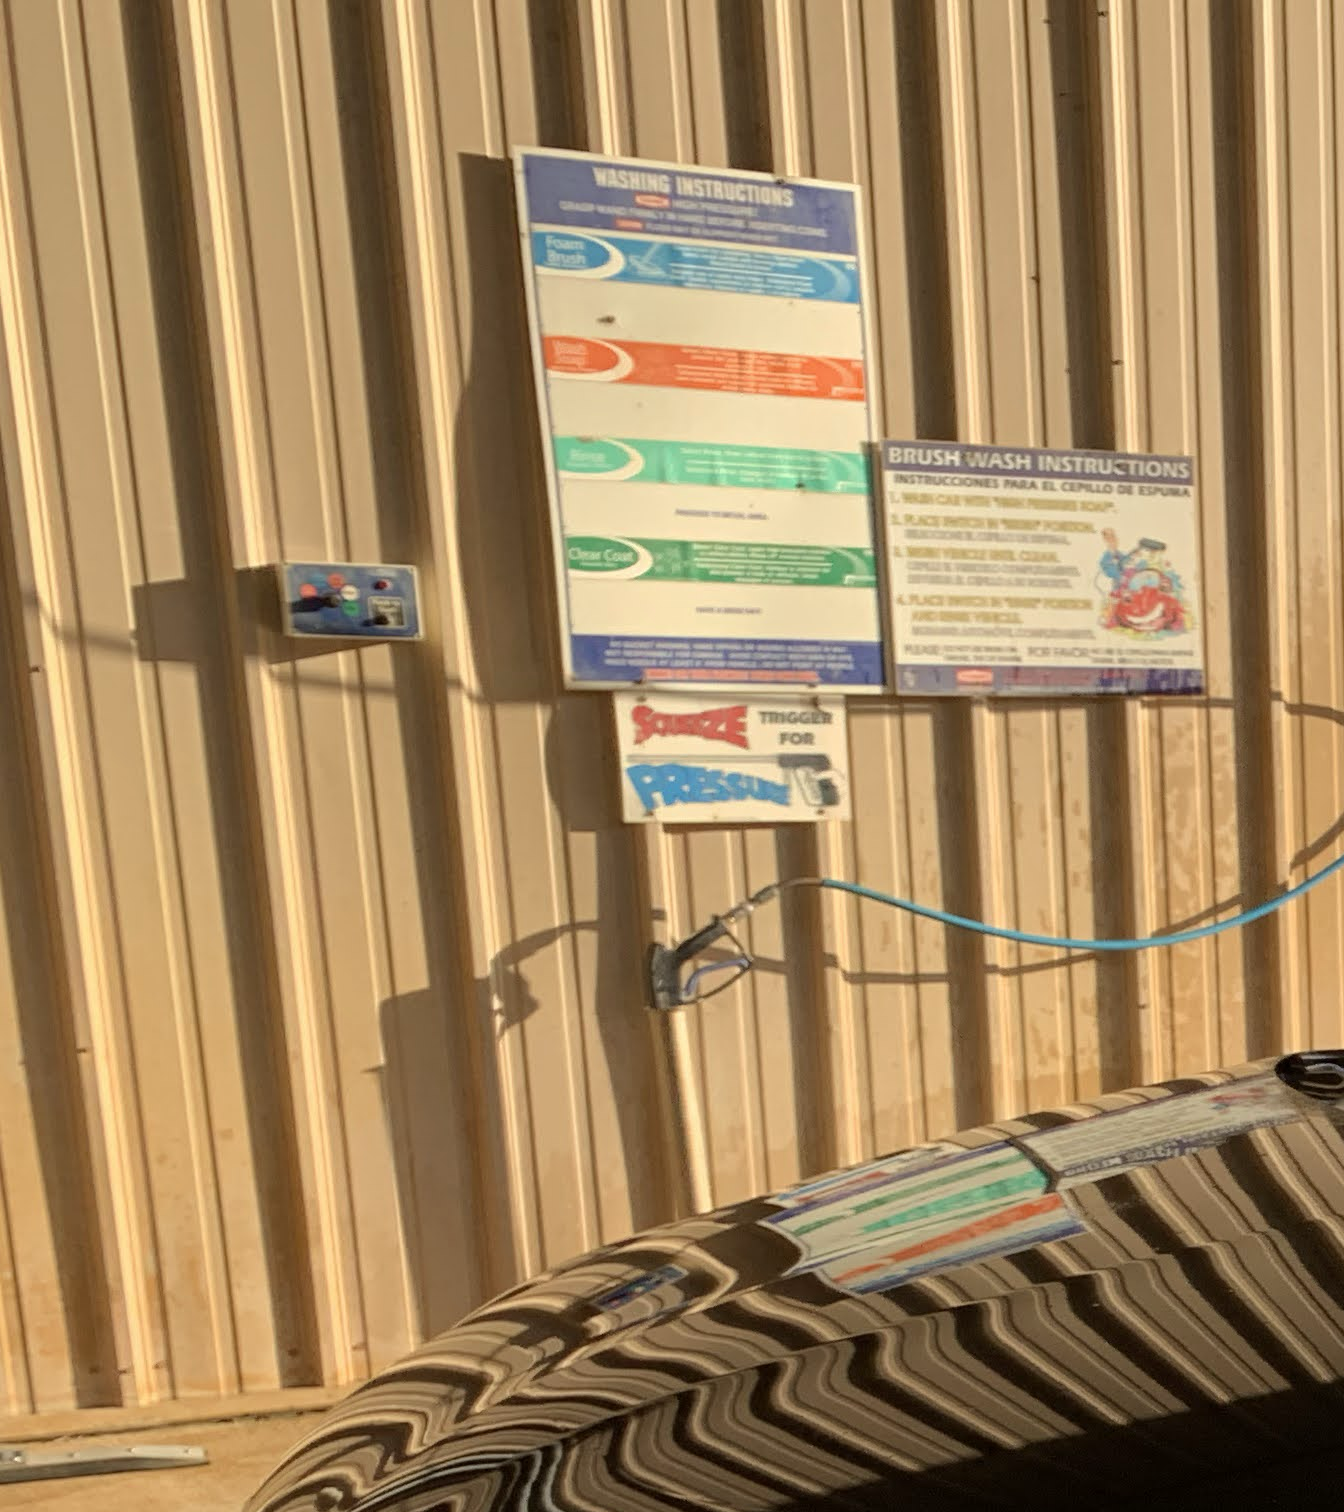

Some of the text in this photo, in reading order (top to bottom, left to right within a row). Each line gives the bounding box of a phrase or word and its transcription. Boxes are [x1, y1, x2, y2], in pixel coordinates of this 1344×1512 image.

[593, 166, 671, 194] WASHING
[675, 175, 795, 207] INSTRUCTIONS
[545, 235, 585, 250] Foam
[546, 249, 586, 265] Brush
[888, 446, 1191, 479] BRUSH WASH INSTRUCTIONS
[893, 473, 1191, 498] INSTRUCCIONES PARA EL CEPILLO DE ESPUMA
[568, 547, 634, 562] Clear Coat
[759, 710, 833, 725] TRIGGER
[779, 732, 815, 746] FOR
